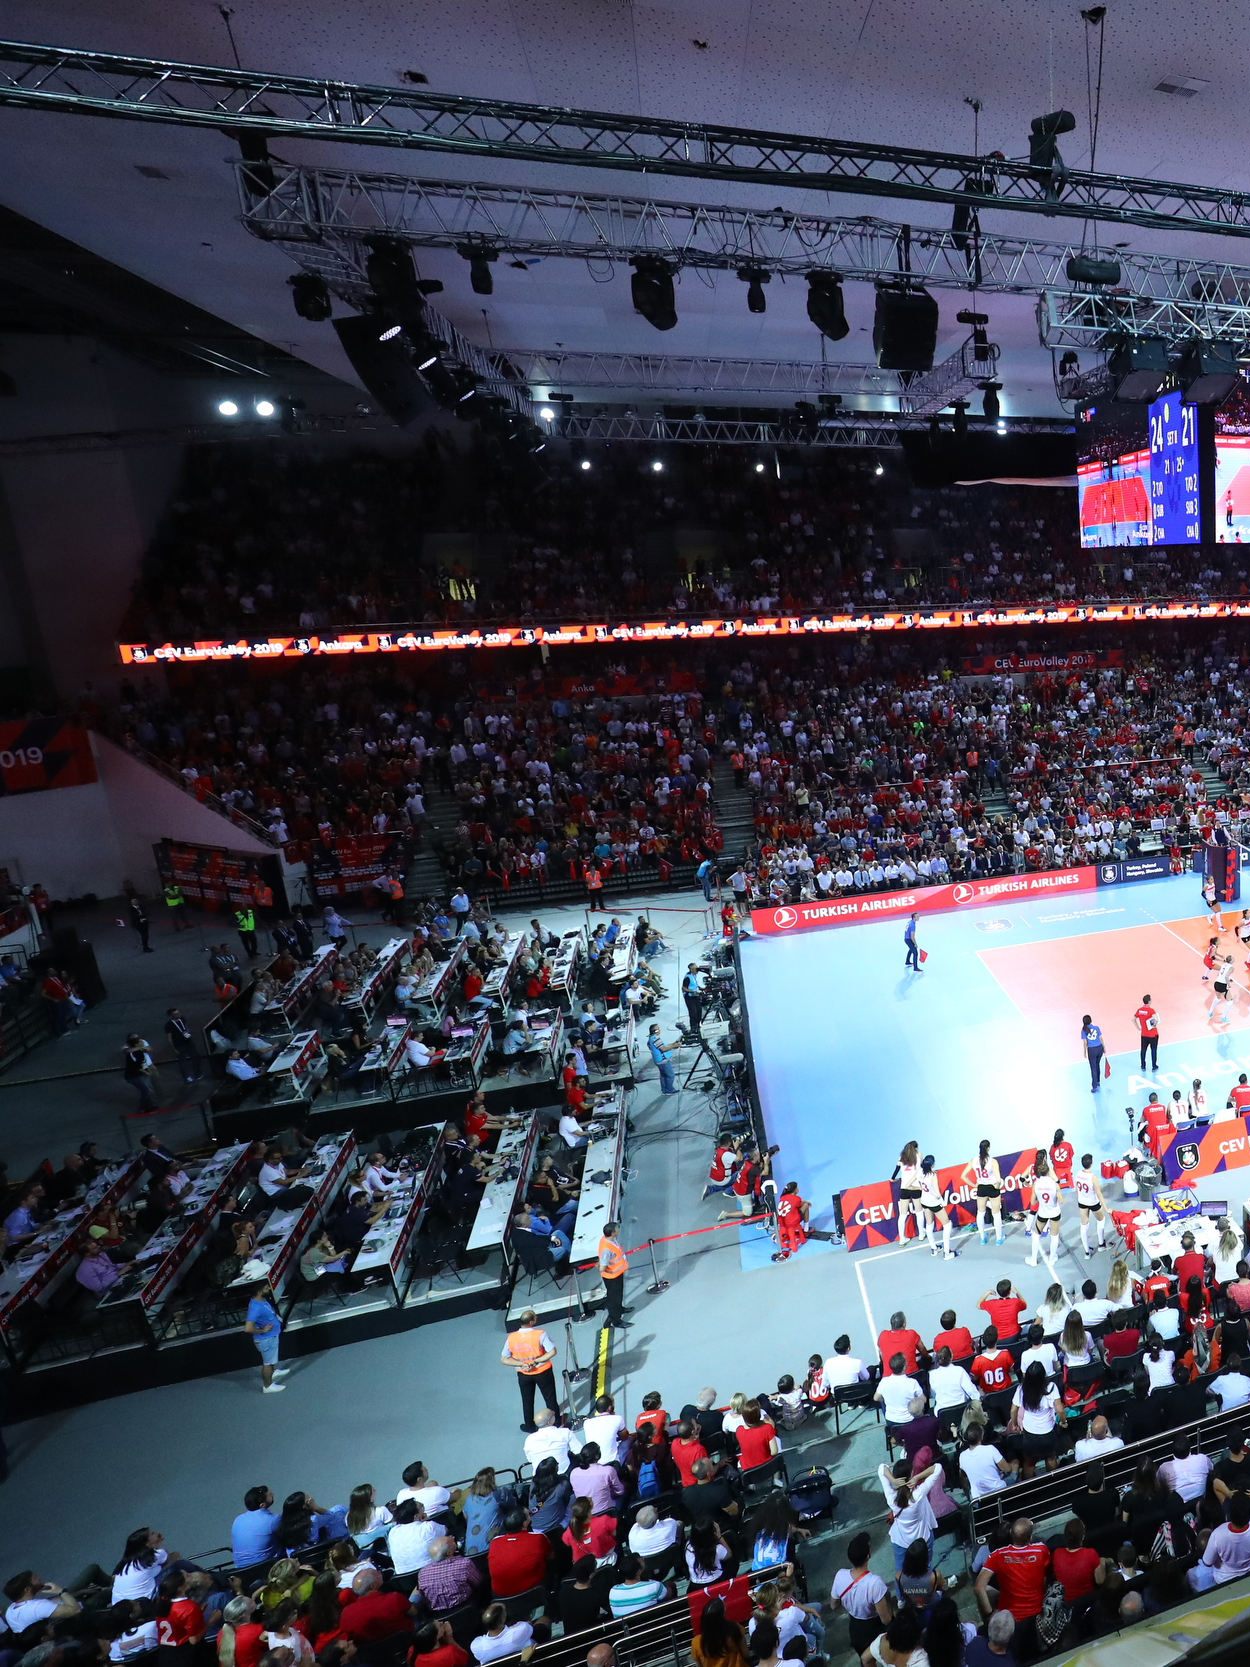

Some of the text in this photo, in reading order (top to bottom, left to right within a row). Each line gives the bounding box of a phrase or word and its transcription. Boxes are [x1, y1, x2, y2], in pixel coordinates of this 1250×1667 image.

[1151, 406, 1194, 454] 24 21
[1166, 431, 1174, 446] SET
[1152, 481, 1156, 497] 2
[1193, 474, 1198, 492] 2
[1194, 498, 1198, 516] 3
[1154, 525, 1158, 542] 2
[1194, 522, 1199, 540] 0
[977, 610, 1067, 623] CEV EuroVolley 2019
[1092, 609, 1123, 619] Ankara
[1146, 606, 1217, 618] CEV EuroVolley 2019
[741, 622, 776, 633] Ankara
[804, 617, 894, 631] CEV EuroVolley 2019
[919, 615, 950, 626] Ankara
[542, 631, 581, 641] Ankara
[612, 624, 713, 638] CEV EuroVolley 2019
[319, 639, 362, 651] Ankara
[397, 633, 511, 648] CEV EuroVolley 2019
[154, 643, 283, 658] CEV EuroVolley 2019
[1018, 656, 1069, 668] EuroVolley
[978, 873, 1079, 896] TURKISH AIRLINES
[802, 896, 916, 920] TURKISH AIRLINES
[1176, 1104, 1186, 1114] 11
[1219, 1137, 1245, 1155] CEV
[976, 1168, 989, 1178] 18
[1076, 1181, 1090, 1194] 99
[1042, 1192, 1050, 1204] 9
[855, 1202, 894, 1226] CEV
[984, 1367, 1004, 1385] 06
[811, 1382, 826, 1397] 06
[159, 1620, 176, 1647] 2
